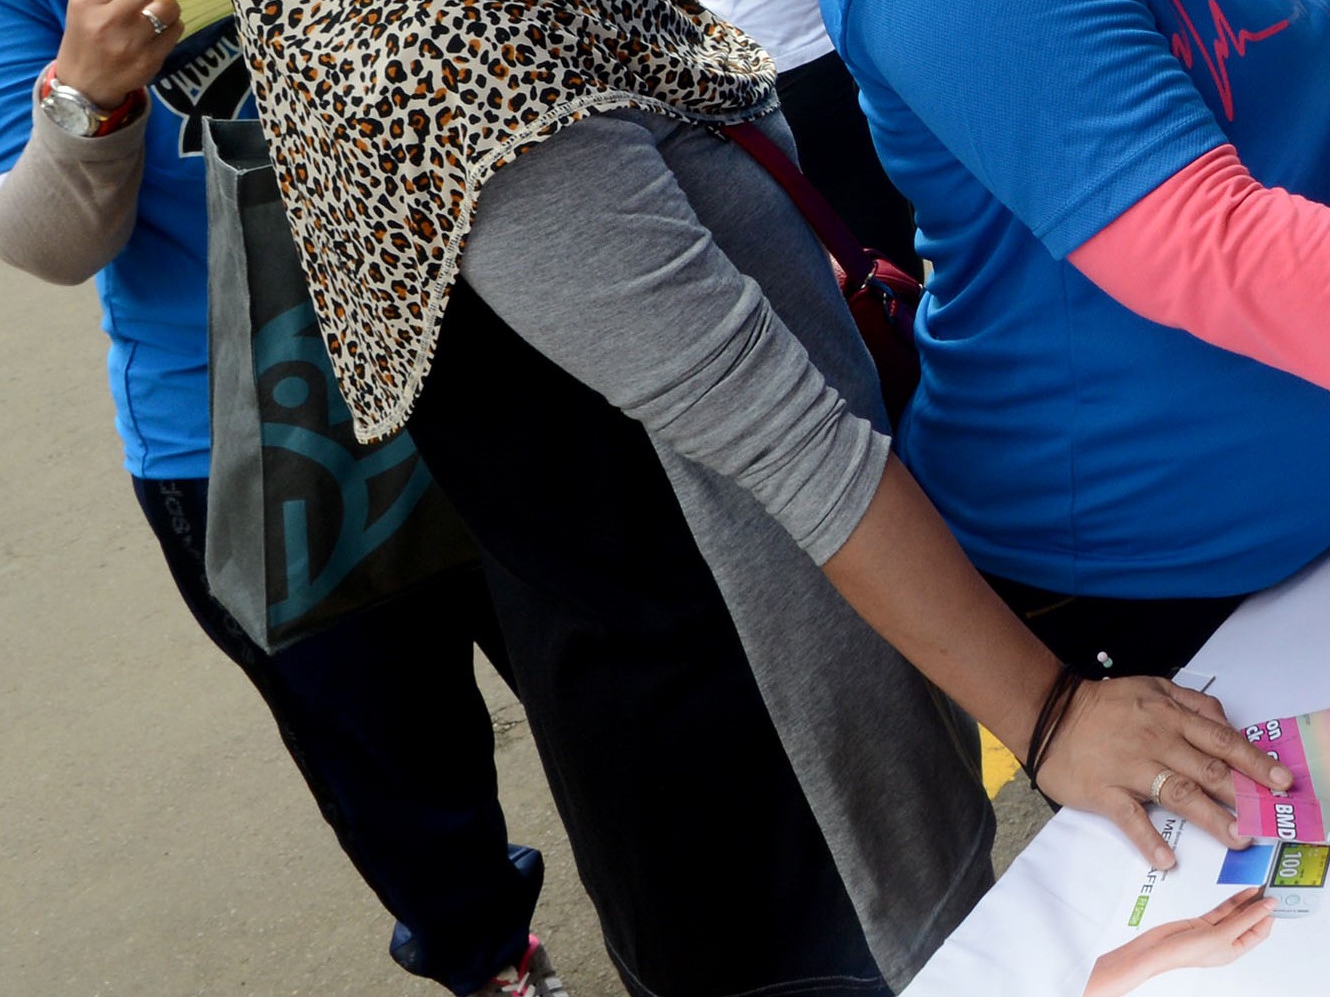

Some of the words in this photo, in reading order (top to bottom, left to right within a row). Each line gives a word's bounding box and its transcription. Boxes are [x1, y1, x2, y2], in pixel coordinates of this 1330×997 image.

[1274, 803, 1298, 840] BMD
[1140, 818, 1177, 894] MEAFE
[1279, 851, 1302, 878] 100
